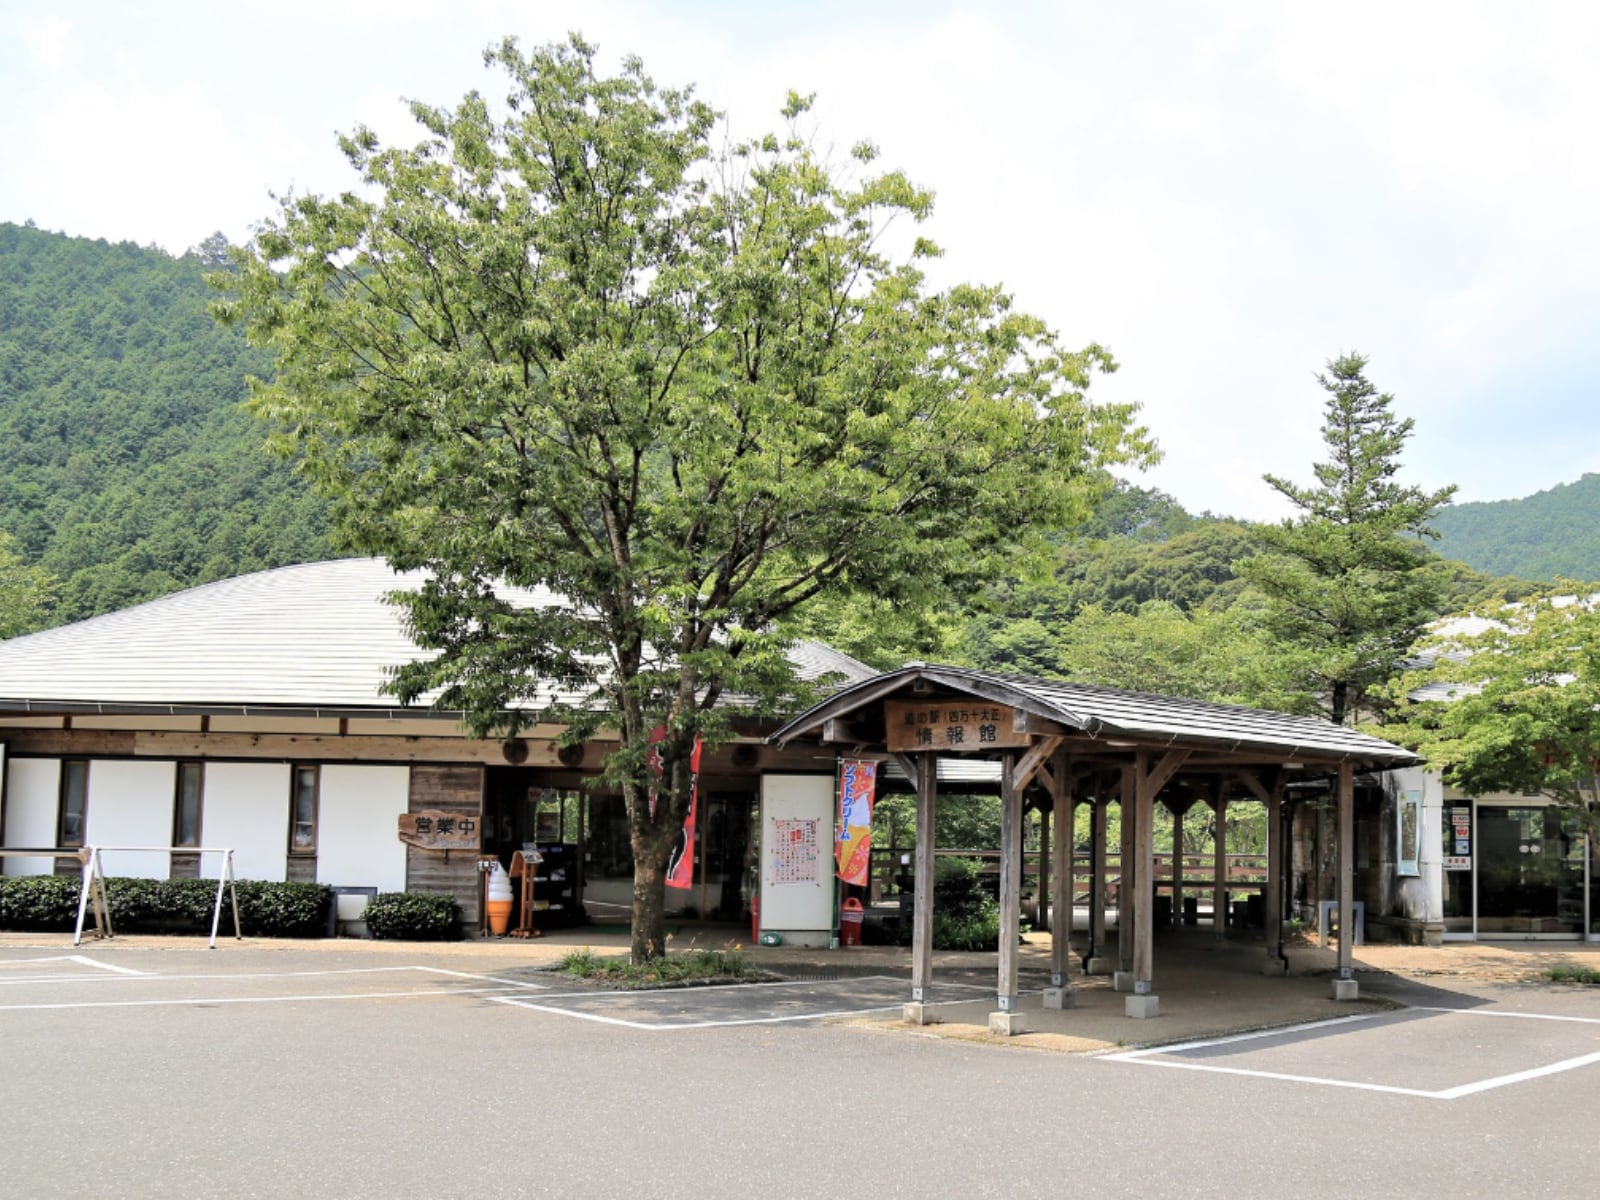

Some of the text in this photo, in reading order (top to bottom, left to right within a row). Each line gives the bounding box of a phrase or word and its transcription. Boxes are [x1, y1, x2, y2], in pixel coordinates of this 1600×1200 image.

[916, 723, 997, 745] 情報館
[840, 764, 857, 841] ソフトクリーム
[416, 817, 475, 835] 営業中
